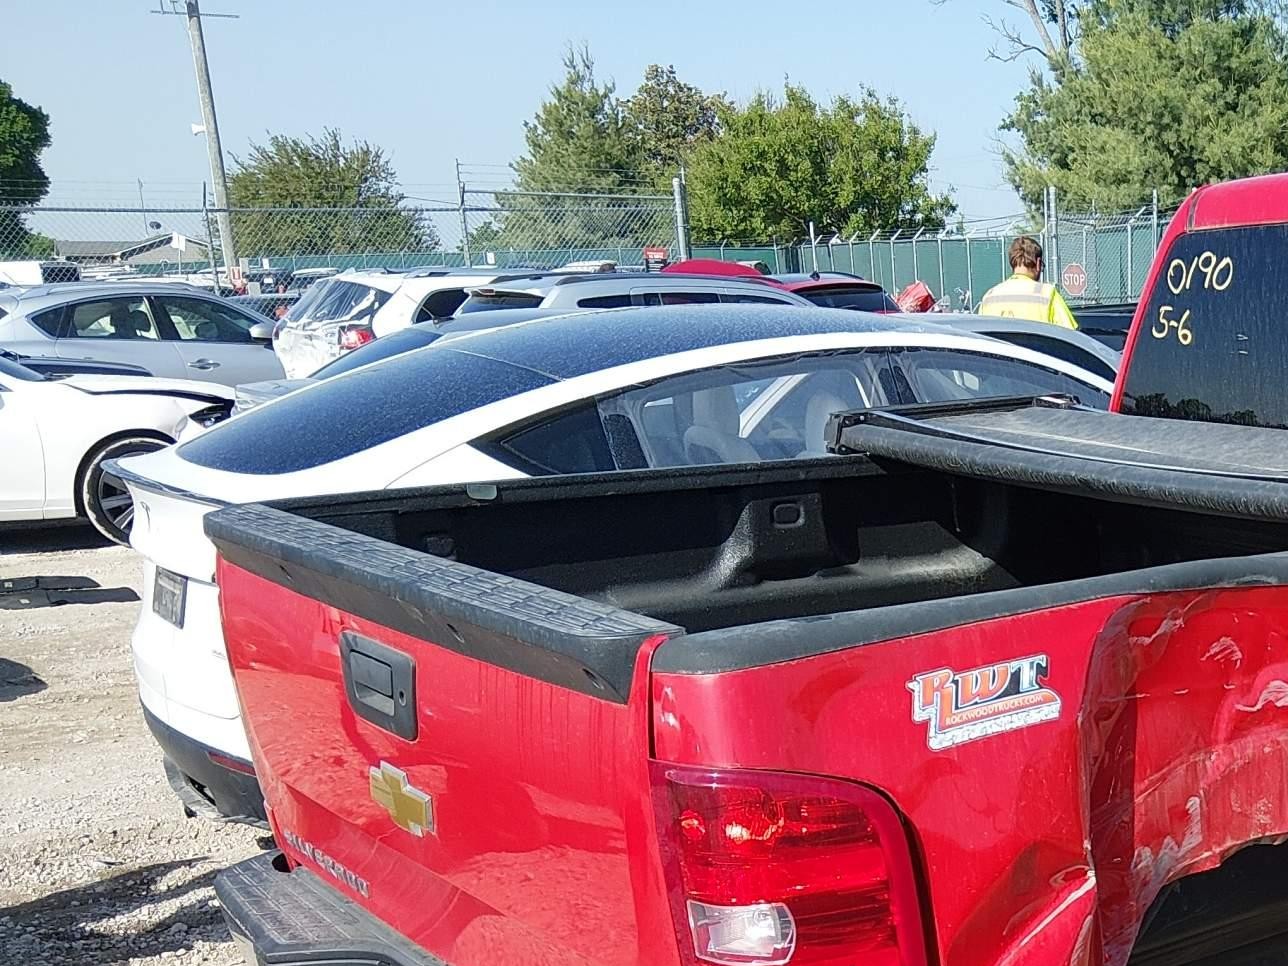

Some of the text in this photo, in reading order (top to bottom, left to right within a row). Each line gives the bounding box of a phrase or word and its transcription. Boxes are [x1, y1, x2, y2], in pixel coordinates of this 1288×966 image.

[1064, 273, 1085, 286] STOP
[1167, 250, 1233, 295] 0190
[1151, 305, 1193, 346] 5-6
[944, 693, 1044, 726] ROCKWOODTRUCKS.COM
